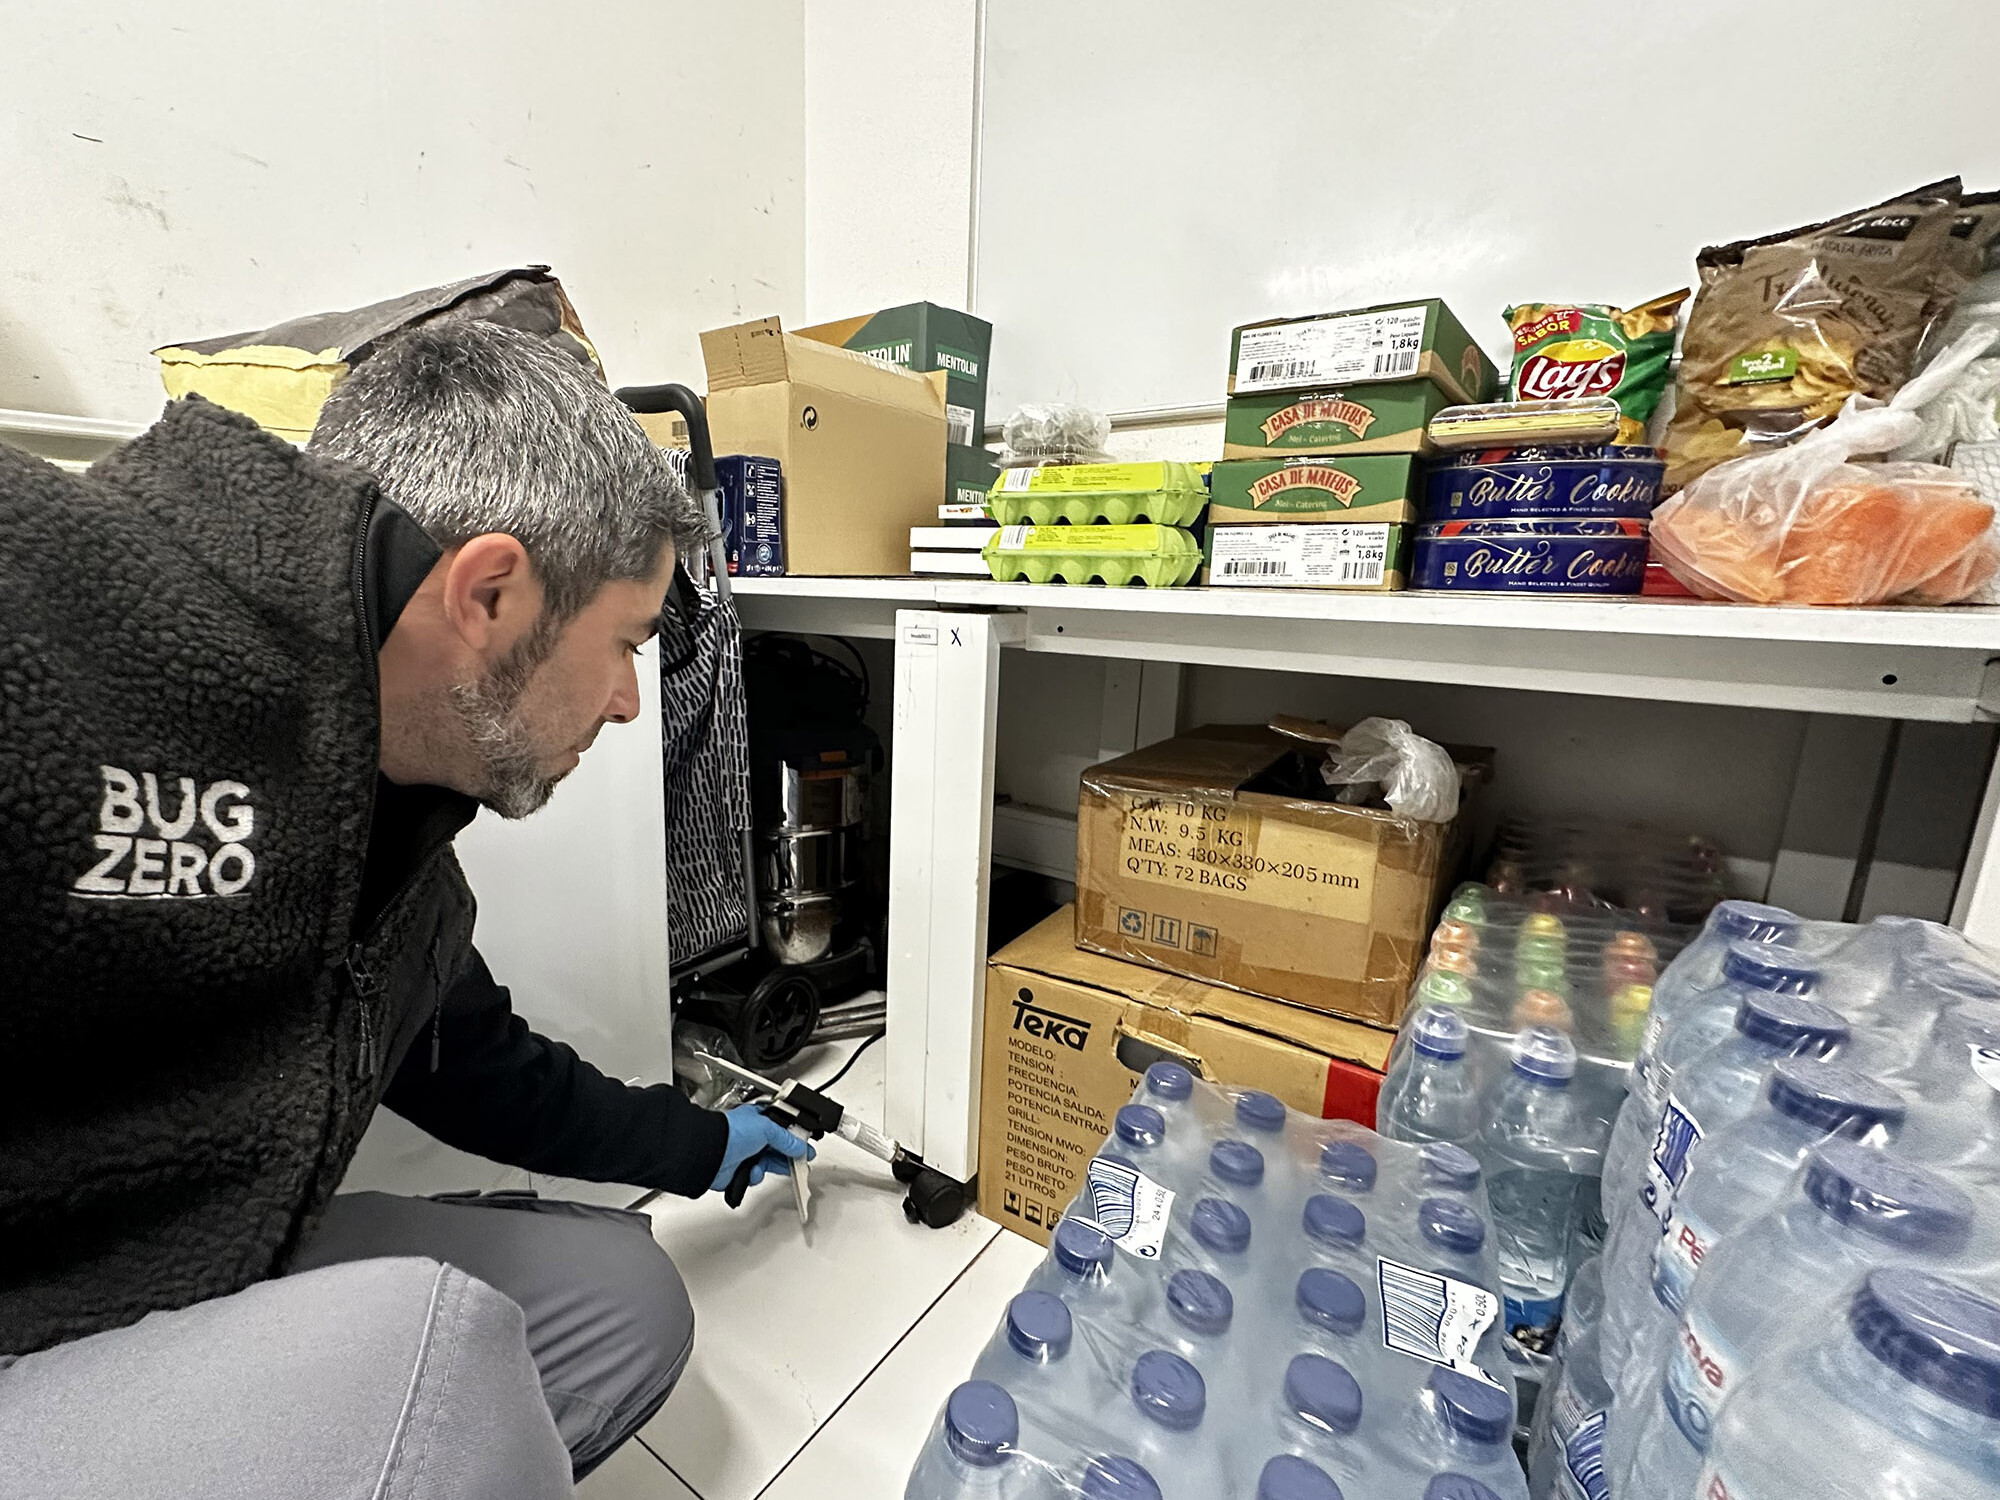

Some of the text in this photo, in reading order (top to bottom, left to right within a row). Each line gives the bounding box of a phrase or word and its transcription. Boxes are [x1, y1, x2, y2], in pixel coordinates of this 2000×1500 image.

[1387, 317, 1399, 325] 120
[1517, 320, 1570, 346] SABOR
[863, 343, 911, 363] TOLIN
[1391, 337, 1419, 351] 1,8kg
[937, 351, 978, 377] MENTOLIN
[1270, 401, 1368, 432] CASA DE MATEUS
[1308, 433, 1342, 444] Catering
[1257, 468, 1354, 496] CASA DE MATEUS
[1468, 467, 1557, 507] Butter
[1295, 500, 1328, 509] Catering
[1352, 529, 1364, 537] 120
[1358, 549, 1384, 561] 1,8kg
[1464, 539, 1645, 580] Butter Cookie
[100, 765, 255, 843] BUG
[1131, 796, 1227, 823] G.W: 10 KG
[1129, 816, 1243, 847] N.W: 9.5 KG
[74, 834, 256, 897] ZERO
[1126, 856, 1248, 892] Q'TY: 72 BAGS
[1128, 836, 1182, 859] MEAS:
[1321, 871, 1360, 890] mm
[1007, 1050, 1054, 1075] TENSION
[1008, 1036, 1056, 1061] MODELO:
[1007, 1078, 1106, 1121] POTENCIA SALIDA:
[1007, 1091, 1109, 1136] POTENCIA ENTRAD
[1007, 1105, 1040, 1125] GRILL:
[1006, 1131, 1068, 1164] DIMENSION:
[1007, 1118, 1087, 1157] TENSION MWO:
[1005, 1158, 1068, 1192] PESO NETO:
[1006, 1145, 1077, 1181] PESO BRUTO:
[1004, 1170, 1057, 1199] 21 LITROS
[1151, 1210, 1161, 1221] 24
[1456, 1335, 1468, 1357] 24
